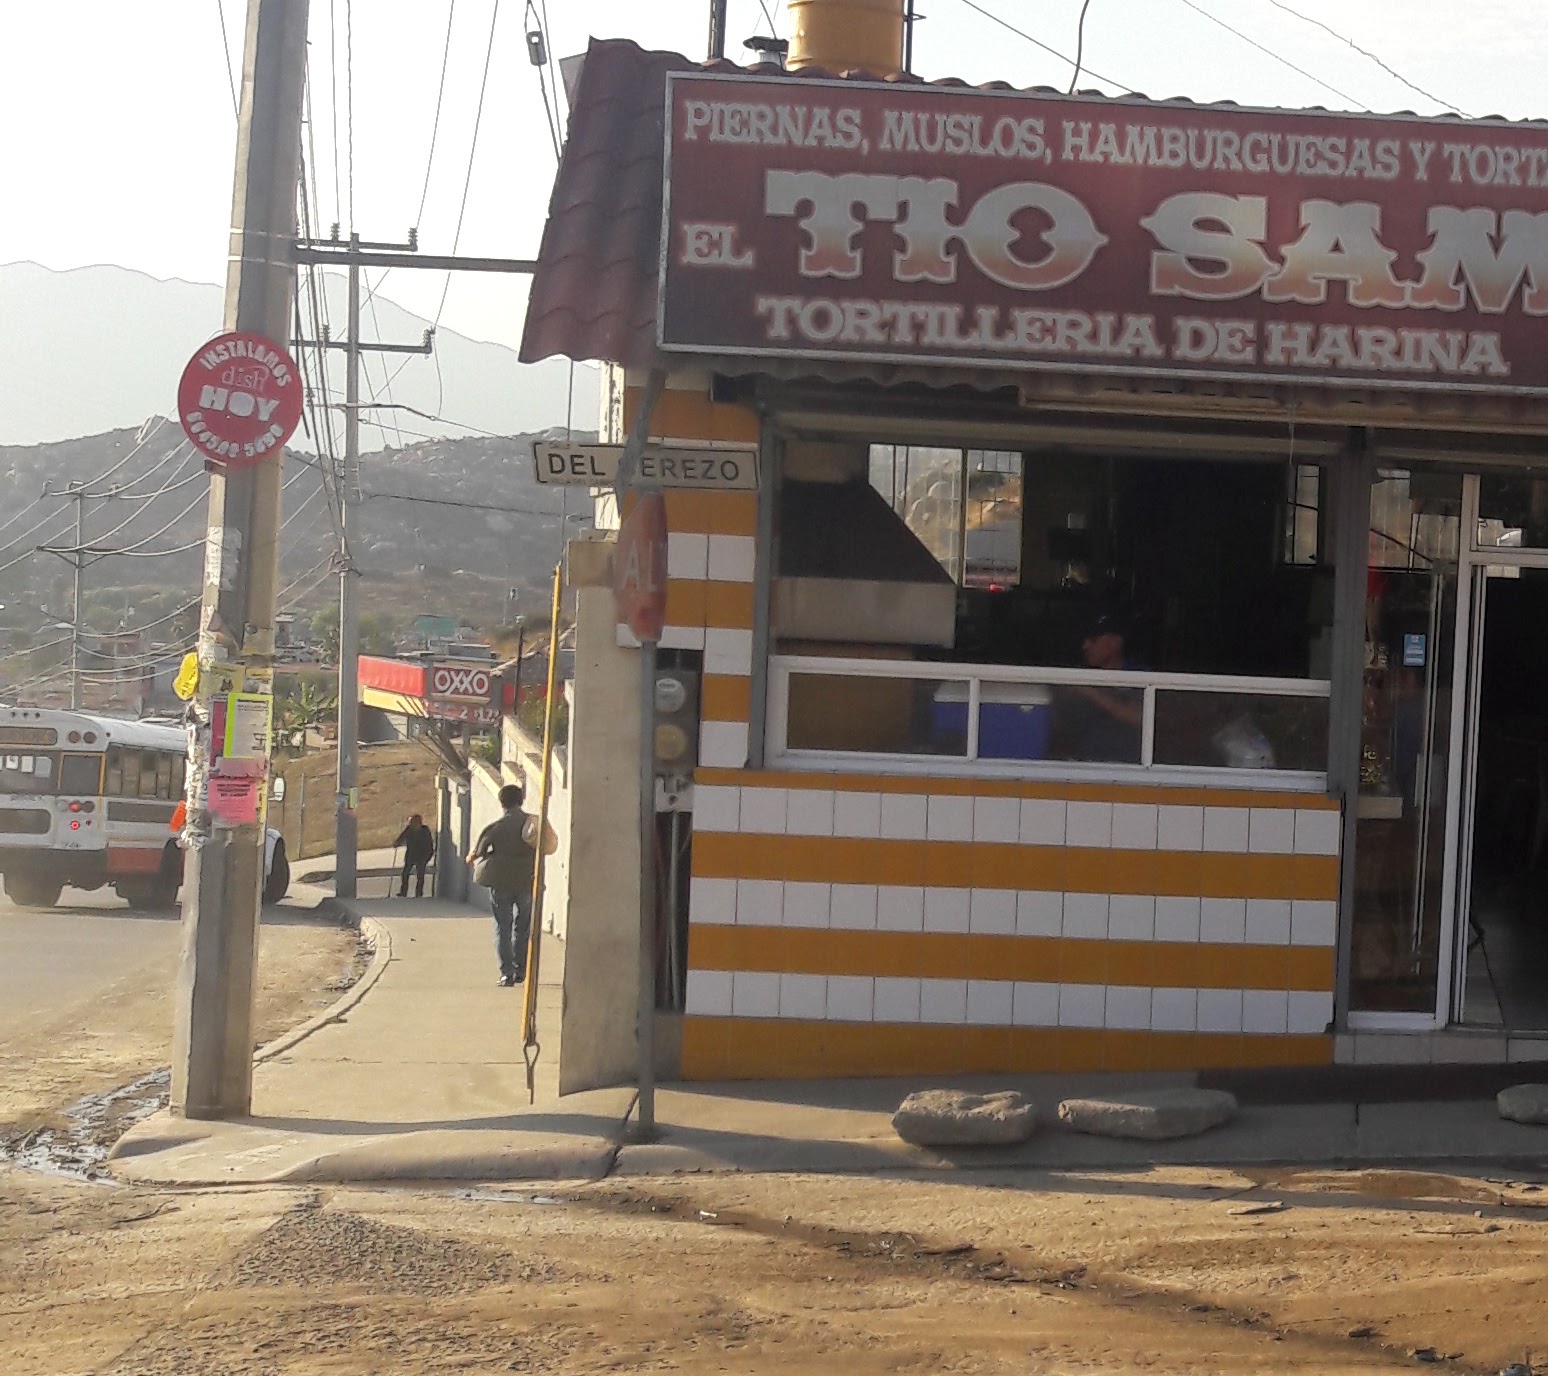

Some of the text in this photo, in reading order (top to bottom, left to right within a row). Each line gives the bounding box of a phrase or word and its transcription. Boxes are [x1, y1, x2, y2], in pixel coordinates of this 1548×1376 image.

[684, 100, 868, 155] PIERNAS,
[879, 109, 1052, 165] MUSLOS,
[1061, 119, 1401, 180] HAMBURGUESAS
[1407, 137, 1436, 182] Y
[681, 223, 754, 268] EL
[764, 169, 1109, 291] TIO
[758, 295, 1511, 378] TORTILLERIA DE HARINA
[198, 384, 279, 422] HOY
[548, 453, 739, 481] DEL EREZO
[434, 669, 489, 694] OXXO
